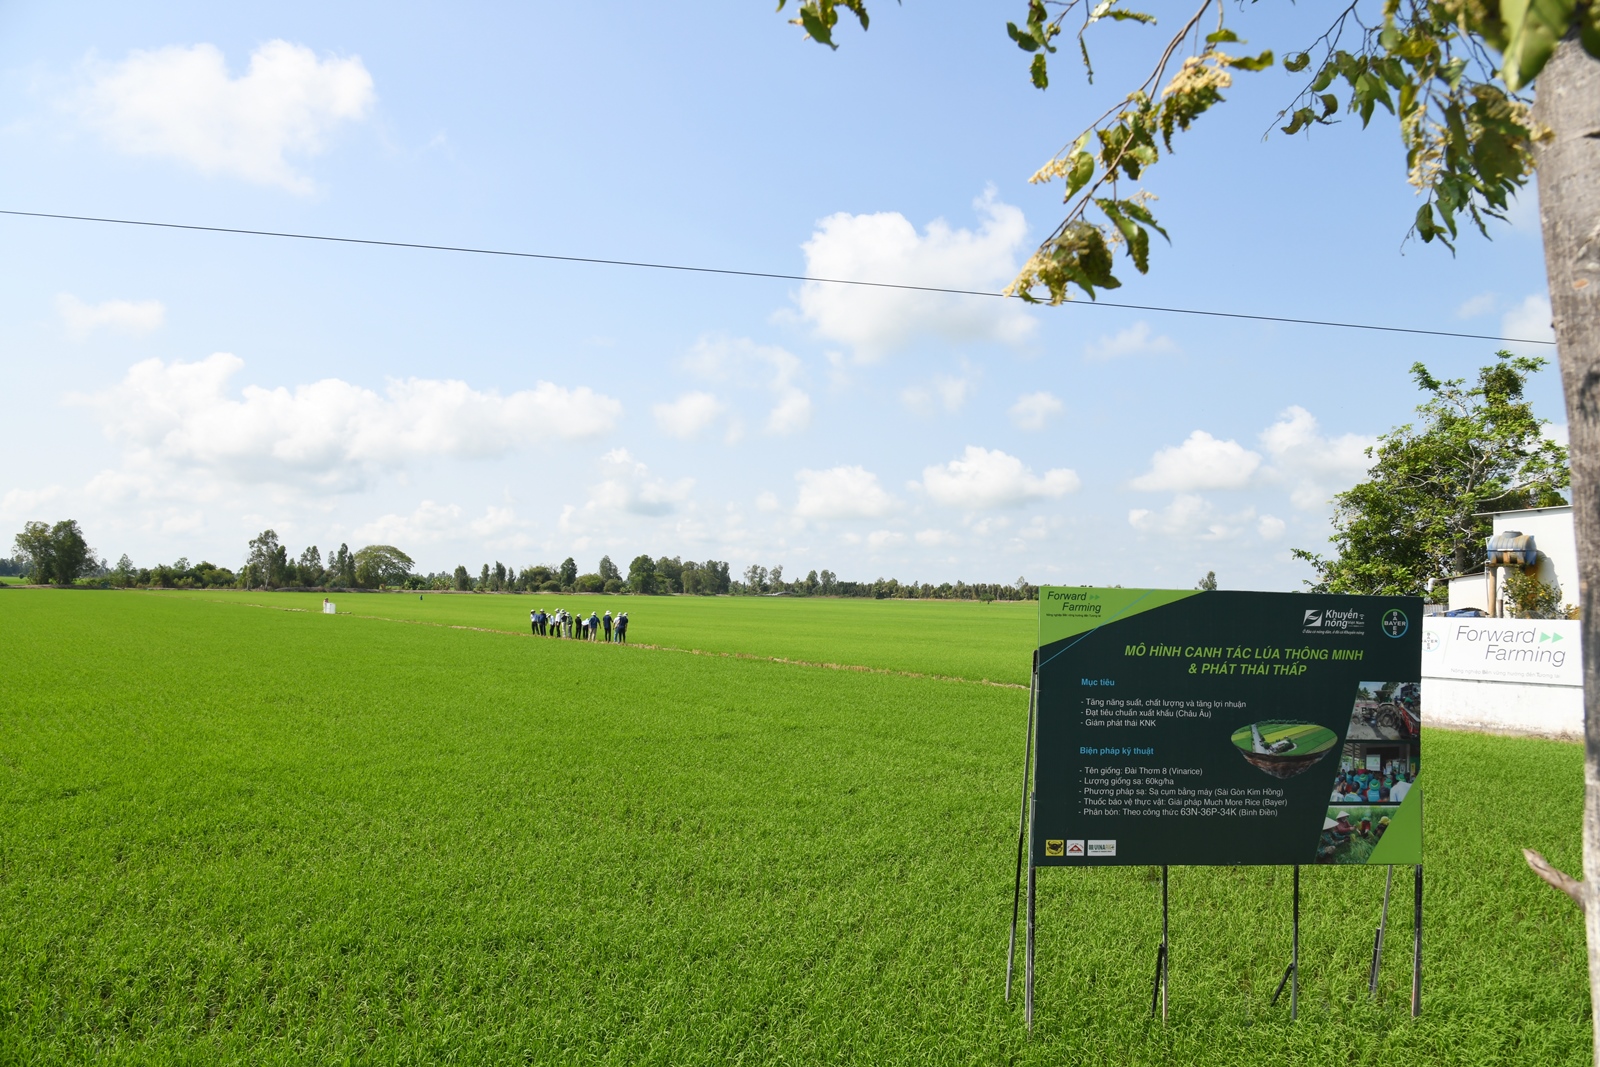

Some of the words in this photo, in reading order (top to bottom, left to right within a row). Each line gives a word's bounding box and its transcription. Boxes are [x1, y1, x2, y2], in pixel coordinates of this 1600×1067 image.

[1047, 591, 1087, 600] Forward
[1062, 602, 1101, 614] Farming
[1325, 608, 1358, 621] Khuyến
[1325, 618, 1347, 629] nông
[1456, 626, 1536, 643] Forward
[1124, 642, 1146, 656] MÔ
[1149, 643, 1181, 656] HÌNH
[1184, 646, 1222, 658] CANH
[1225, 644, 1251, 658] TÁC
[1254, 645, 1279, 659] LÚA
[1284, 646, 1328, 660] THÔNG
[1331, 649, 1363, 660] MINH
[1485, 644, 1566, 668] Farming
[1188, 662, 1197, 674] &
[1201, 660, 1237, 674] PHÁT
[1240, 661, 1269, 674] THẢI
[1273, 662, 1306, 675] THẤP
[1081, 678, 1097, 686] Mục
[1085, 697, 1104, 707] Tăng
[1105, 698, 1124, 707] năng
[1126, 698, 1143, 707] suất,
[1145, 698, 1160, 707] chất
[1162, 699, 1184, 710] lượng
[1196, 700, 1212, 709] tăng
[1224, 700, 1246, 708] nhuận
[1085, 708, 1098, 716] Đạt
[1106, 719, 1122, 727] phát
[1079, 746, 1098, 755] Biện
[1099, 746, 1120, 755] pháp
[1122, 747, 1131, 756] kỹ
[1100, 766, 1122, 776] giống:
[1168, 767, 1202, 776] (Vinarice)
[1084, 777, 1109, 786] Lượng
[1110, 777, 1130, 786] giống
[1145, 777, 1174, 786] 60kg/ha
[1083, 787, 1114, 796] Phương
[1115, 787, 1134, 796] pháp
[1148, 787, 1158, 795] Sạ
[1177, 787, 1195, 797] bằng
[1197, 788, 1212, 796] máy
[1214, 788, 1228, 796] (Sài
[1262, 788, 1283, 797] Hồng)
[1183, 798, 1202, 806] pháp
[1262, 798, 1287, 807] (Bayer)
[1142, 808, 1160, 817] công
[1180, 807, 1236, 816] 63N-36P-34K
[1258, 808, 1277, 816] Điền)
